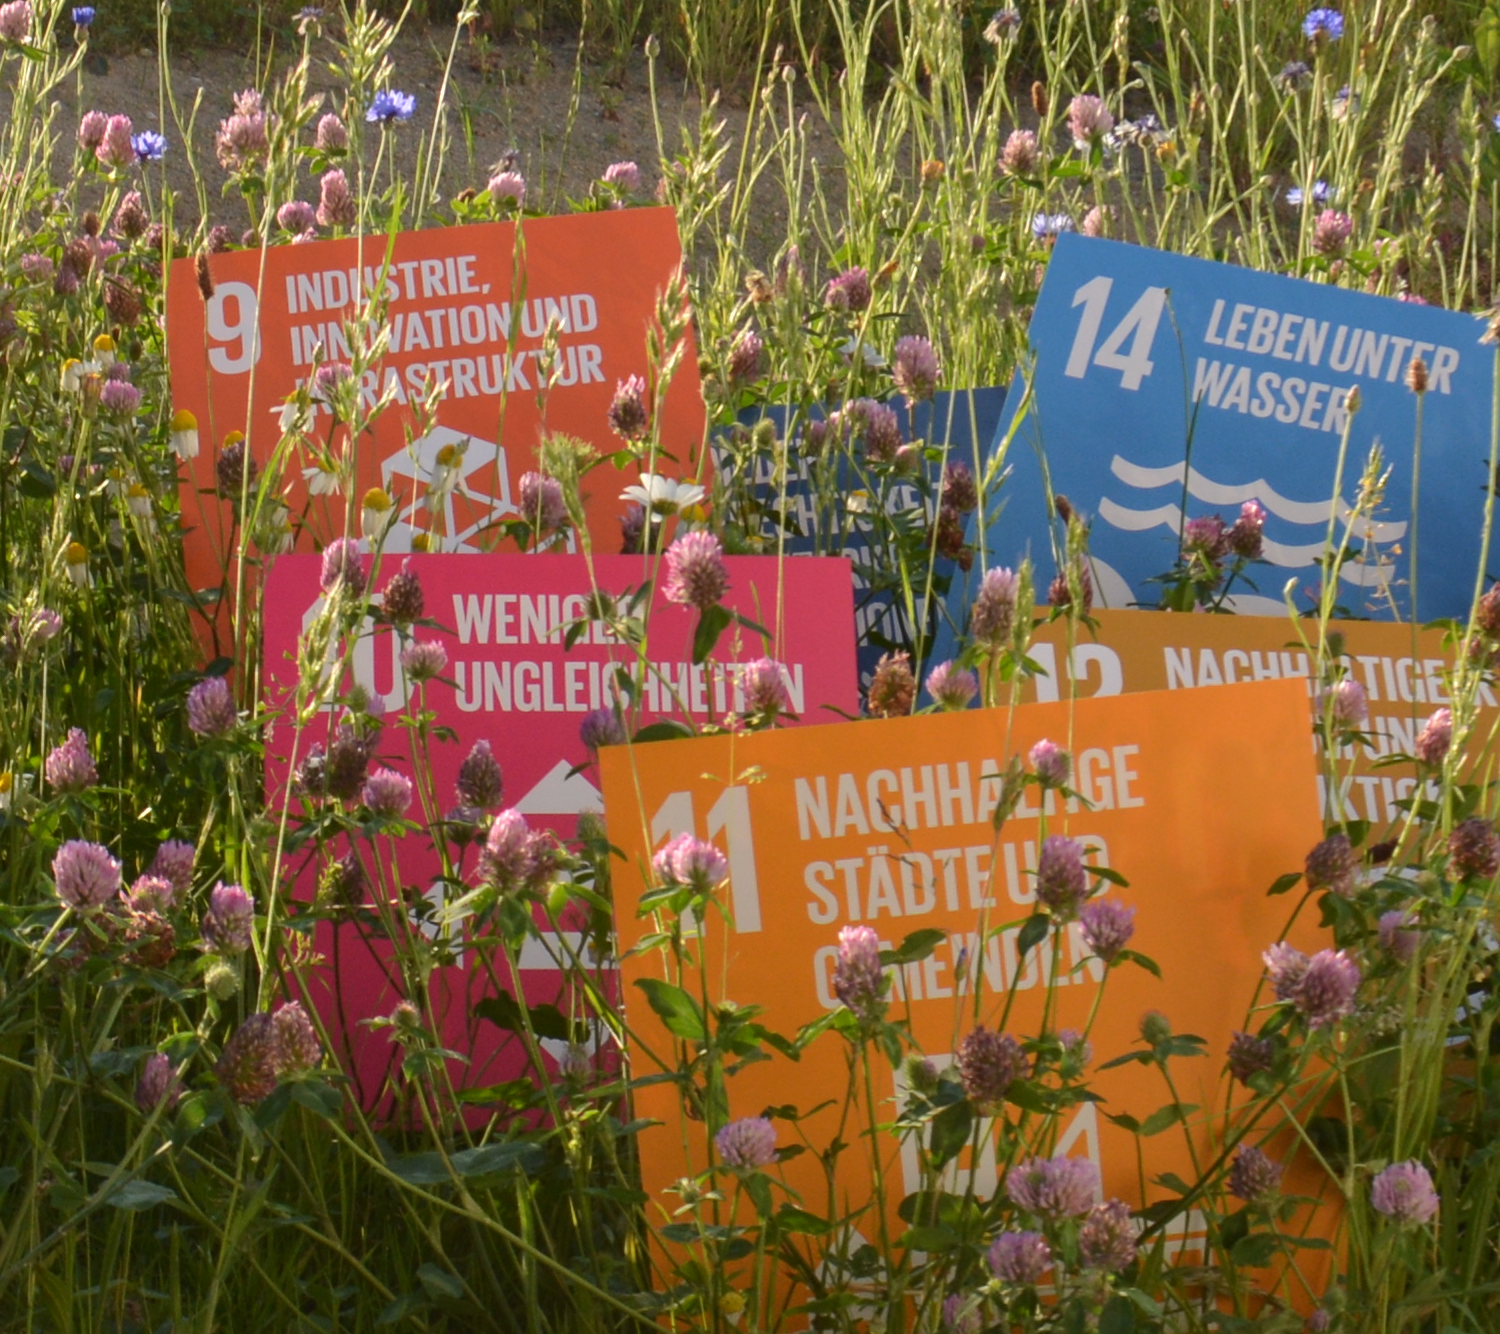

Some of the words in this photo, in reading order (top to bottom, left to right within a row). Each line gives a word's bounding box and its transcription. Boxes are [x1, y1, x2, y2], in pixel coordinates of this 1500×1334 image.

[207, 281, 262, 375] 9
[521, 293, 599, 339] UND
[1064, 275, 1169, 392] 14
[1203, 298, 1331, 367] LEBEN
[1328, 324, 1460, 396] UNTER
[1190, 357, 1350, 435] WASSER
[454, 660, 805, 715] UNGLEICHHEITN
[803, 843, 998, 926] STÄDTE
[1003, 834, 1112, 907] UD
